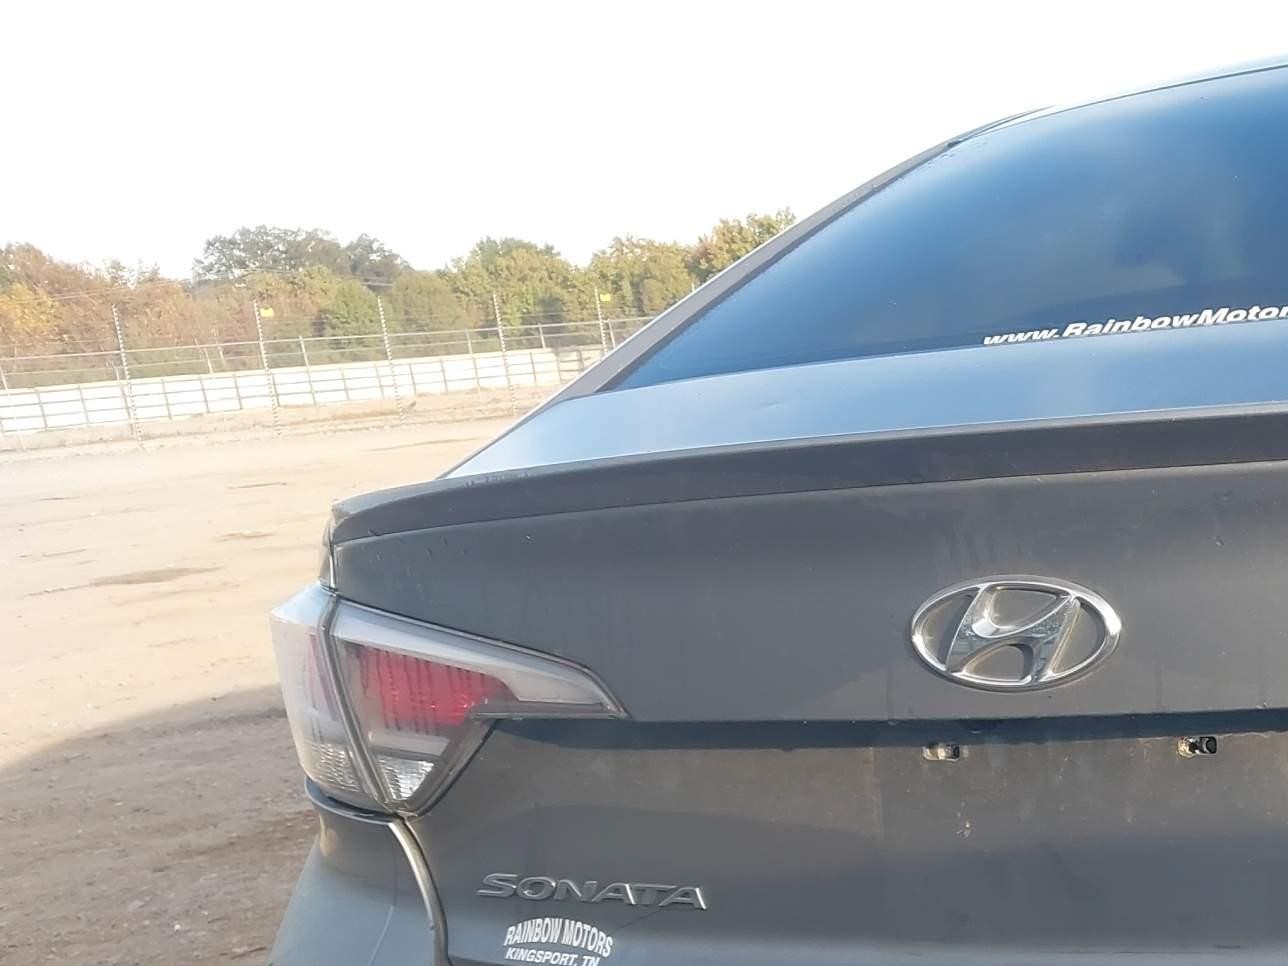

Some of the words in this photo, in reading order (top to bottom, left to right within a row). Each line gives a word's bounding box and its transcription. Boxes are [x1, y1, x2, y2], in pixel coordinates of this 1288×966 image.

[476, 872, 707, 910] SONATA
[504, 917, 562, 946] RAINBOW
[562, 918, 613, 957] MOTORS
